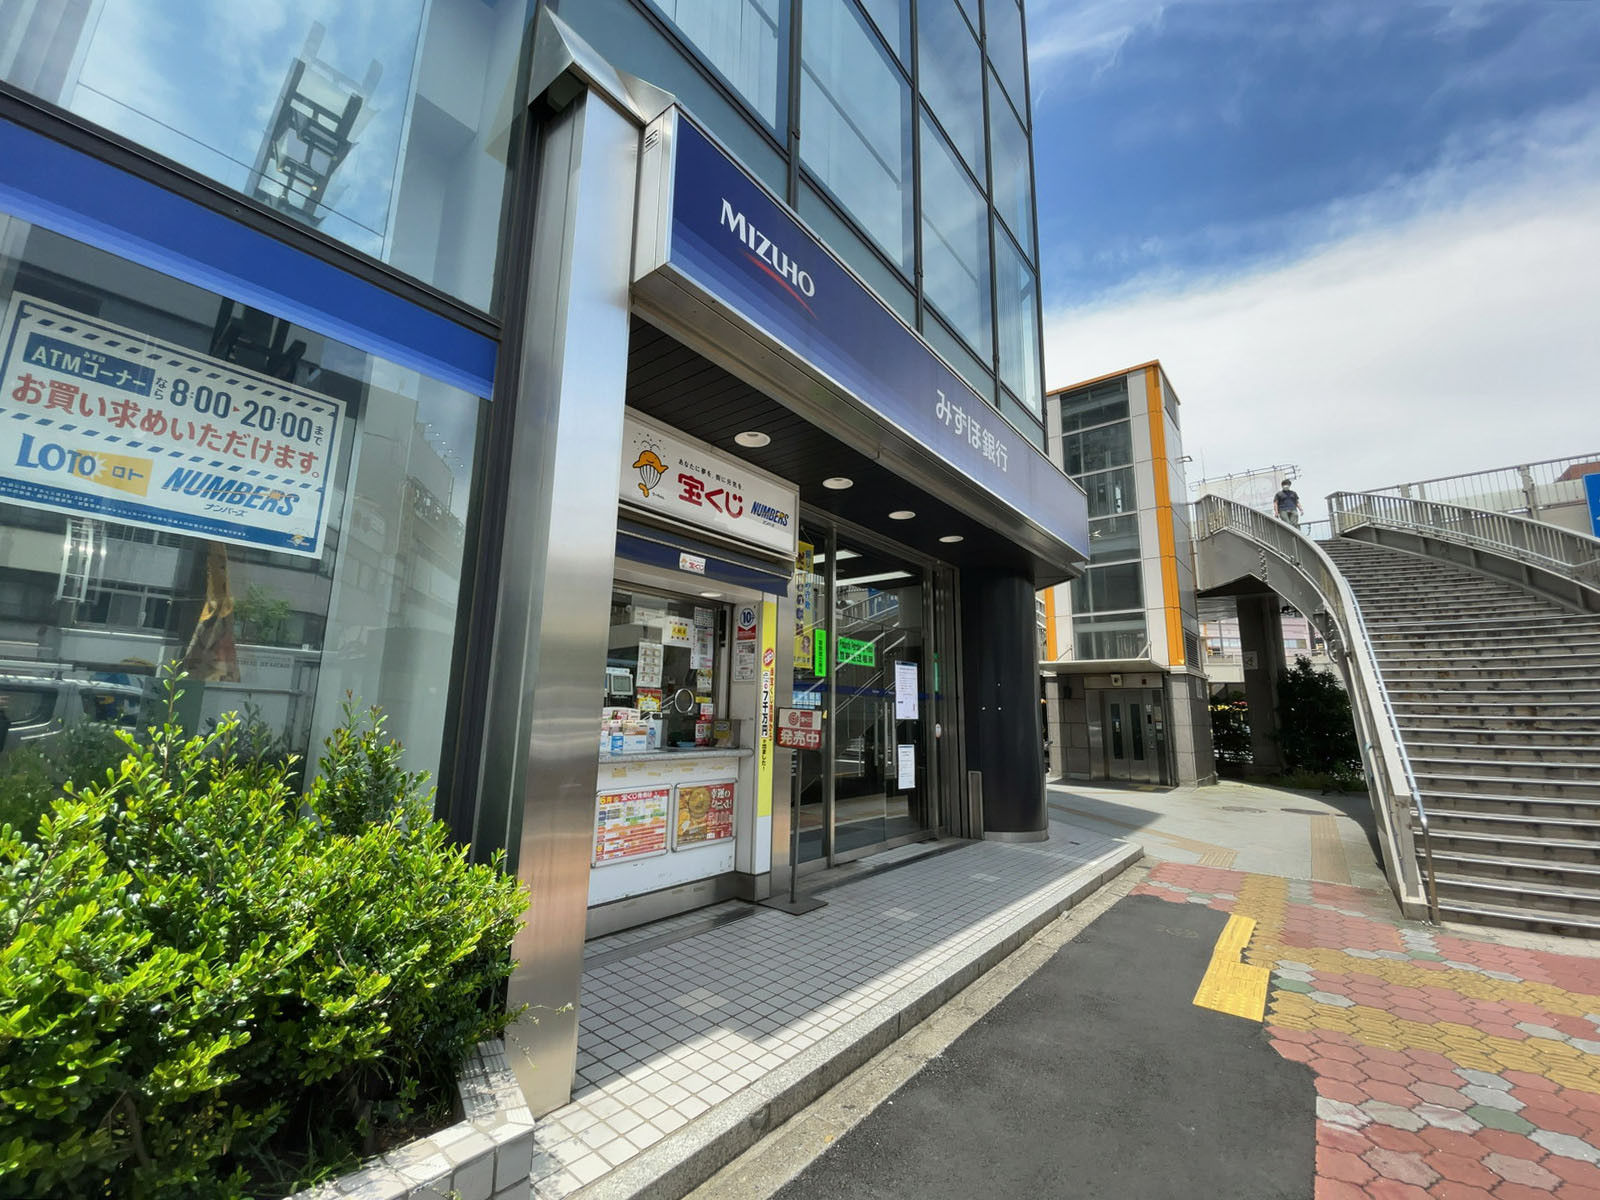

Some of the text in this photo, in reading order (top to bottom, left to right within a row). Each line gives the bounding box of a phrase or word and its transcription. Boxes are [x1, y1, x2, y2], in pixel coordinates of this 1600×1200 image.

[720, 197, 816, 297] MIZUHO
[31, 345, 325, 446] ATMコーナー なら 8:00 20:00 まで
[11, 372, 321, 479] お買い求めいただけます。
[935, 389, 1009, 473] みずほ銀行
[14, 432, 145, 481] LOTO ロト
[161, 466, 301, 517] NUMBERS
[203, 503, 249, 518] ナンバーズ
[678, 472, 744, 519] 宝くじ
[750, 501, 790, 527] NUMBERS
[780, 728, 820, 748] 発売中
